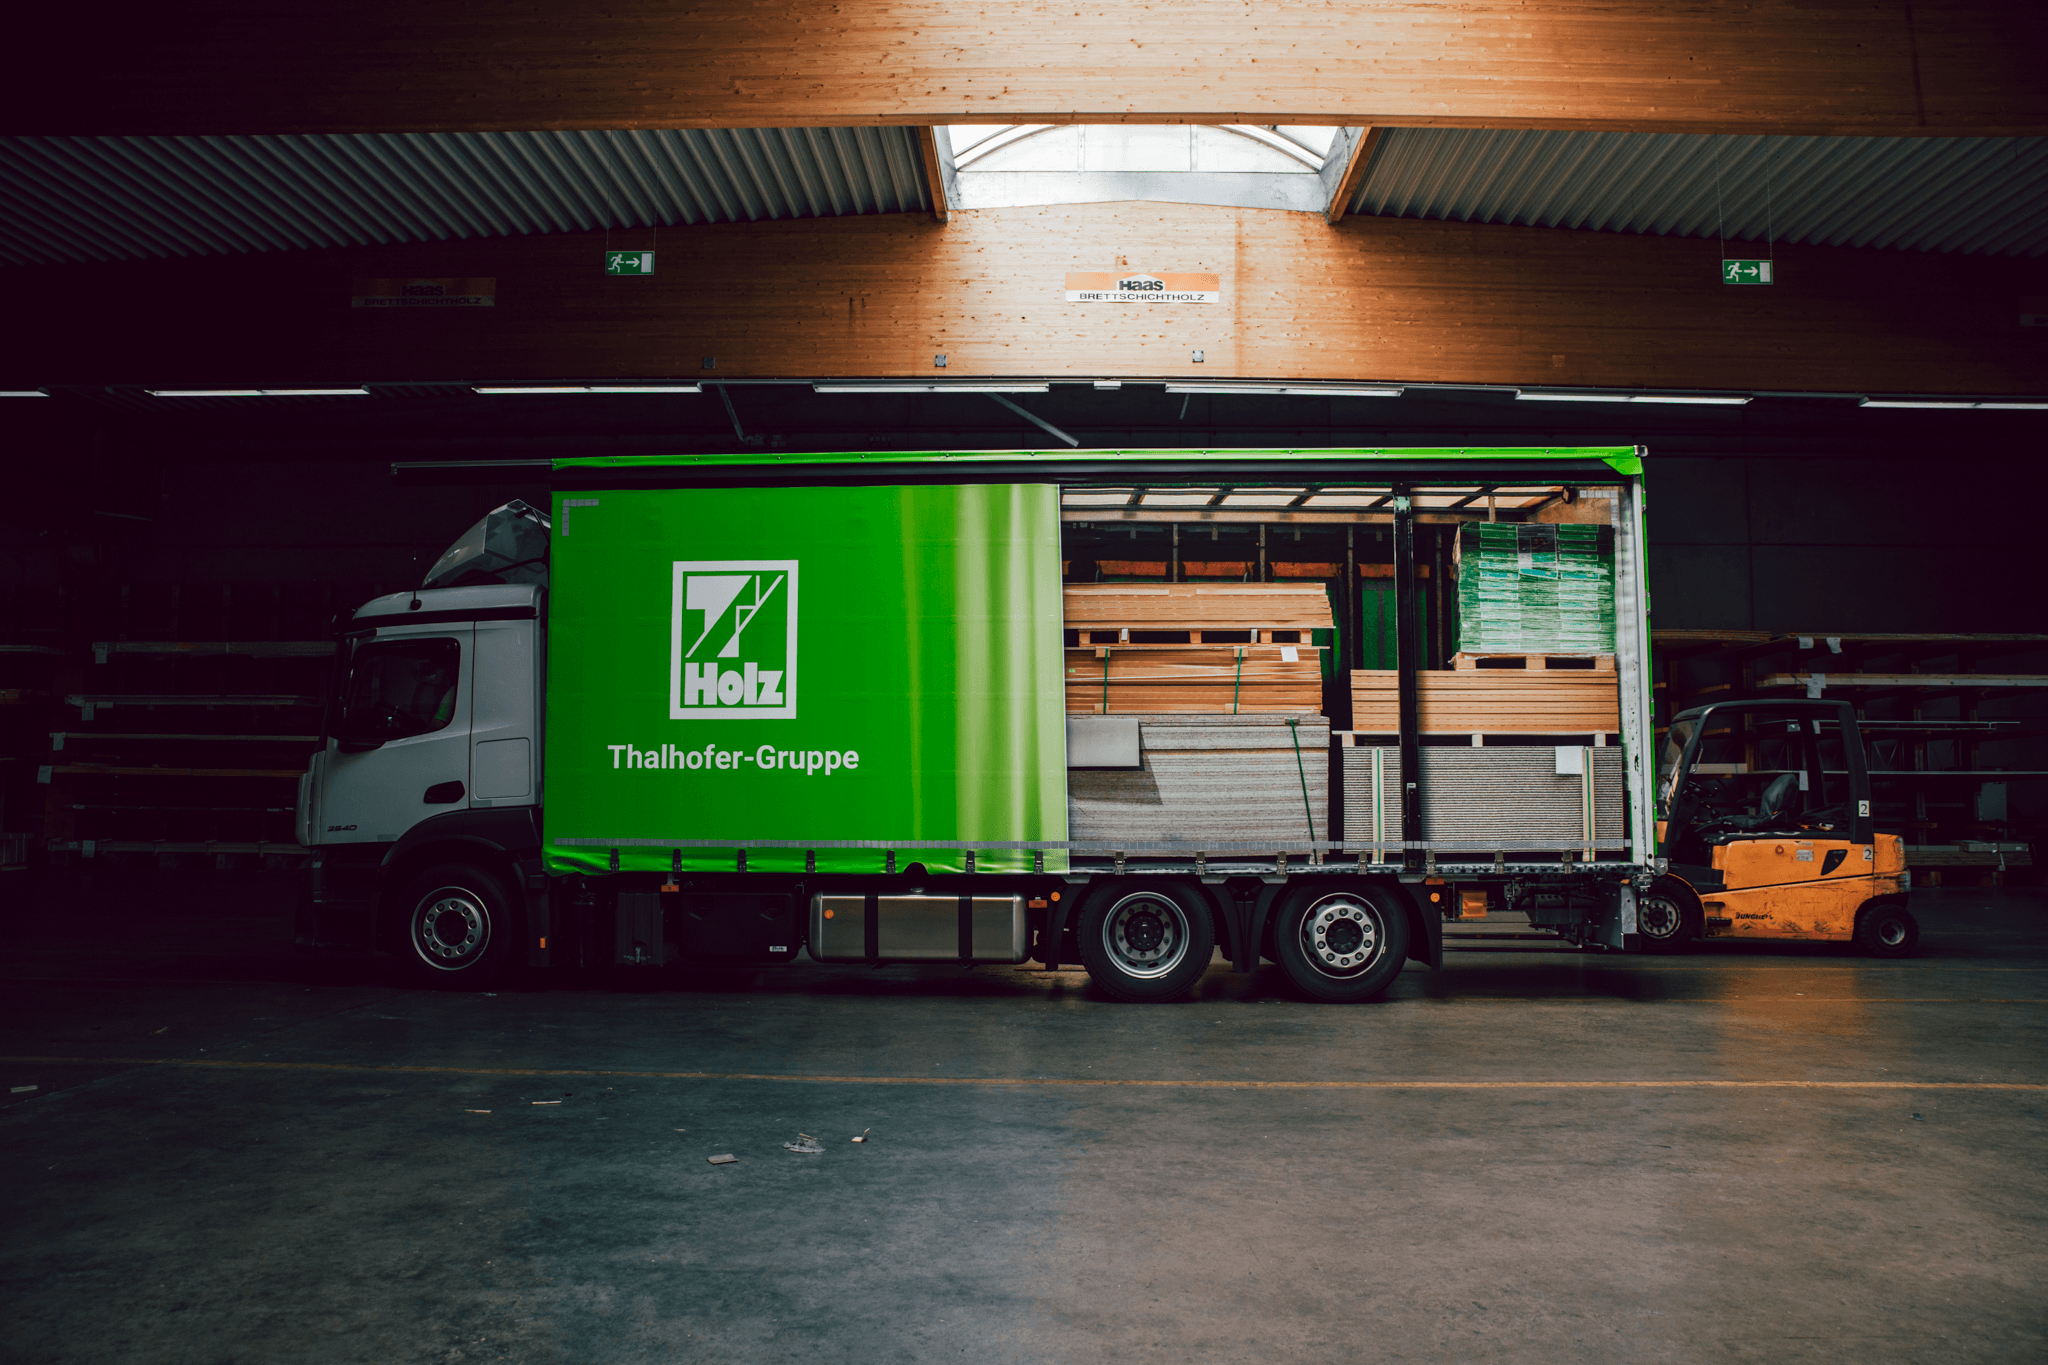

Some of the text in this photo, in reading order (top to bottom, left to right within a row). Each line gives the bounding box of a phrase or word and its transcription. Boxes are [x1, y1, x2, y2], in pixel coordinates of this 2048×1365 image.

[1119, 280, 1164, 291] Haas
[364, 297, 481, 306] BRETTSCHICHTHOLZ
[1079, 293, 1205, 301] BRETTSCHICHTHOLZ
[684, 661, 784, 706] Holz
[607, 743, 860, 776] Thalhofer-Gruppe
[1860, 803, 1868, 815] 2
[1864, 849, 1872, 860] 2
